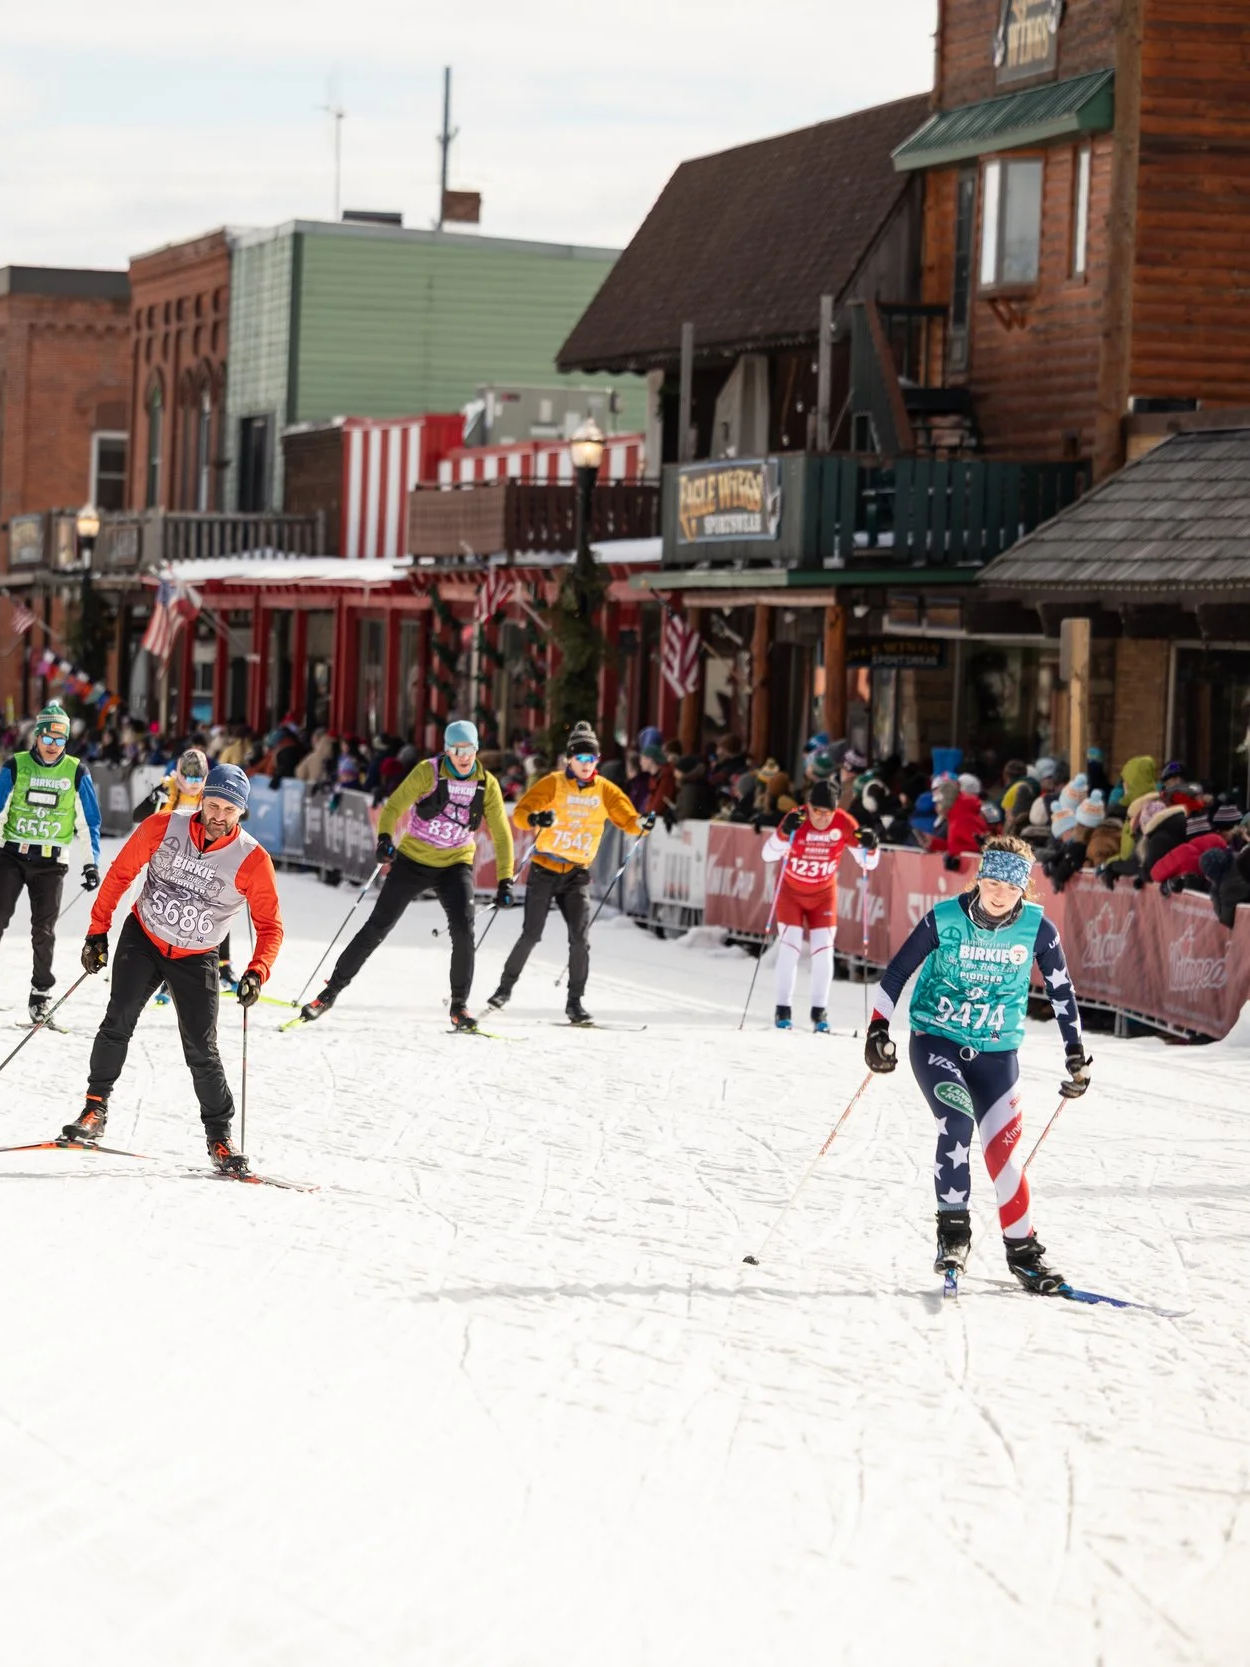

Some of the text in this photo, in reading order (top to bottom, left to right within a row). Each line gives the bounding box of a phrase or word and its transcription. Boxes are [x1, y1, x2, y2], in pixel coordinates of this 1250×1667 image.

[1008, 14, 1051, 68] WINGS
[30, 777, 62, 789] BIRKIE
[16, 817, 62, 839] 6552
[553, 829, 593, 851] 7542
[172, 855, 216, 881] BIRKIE
[152, 890, 214, 934] 5686
[959, 944, 1011, 964] BIRKIE
[935, 996, 1006, 1031] 9474
[927, 1053, 962, 1078] VISA
